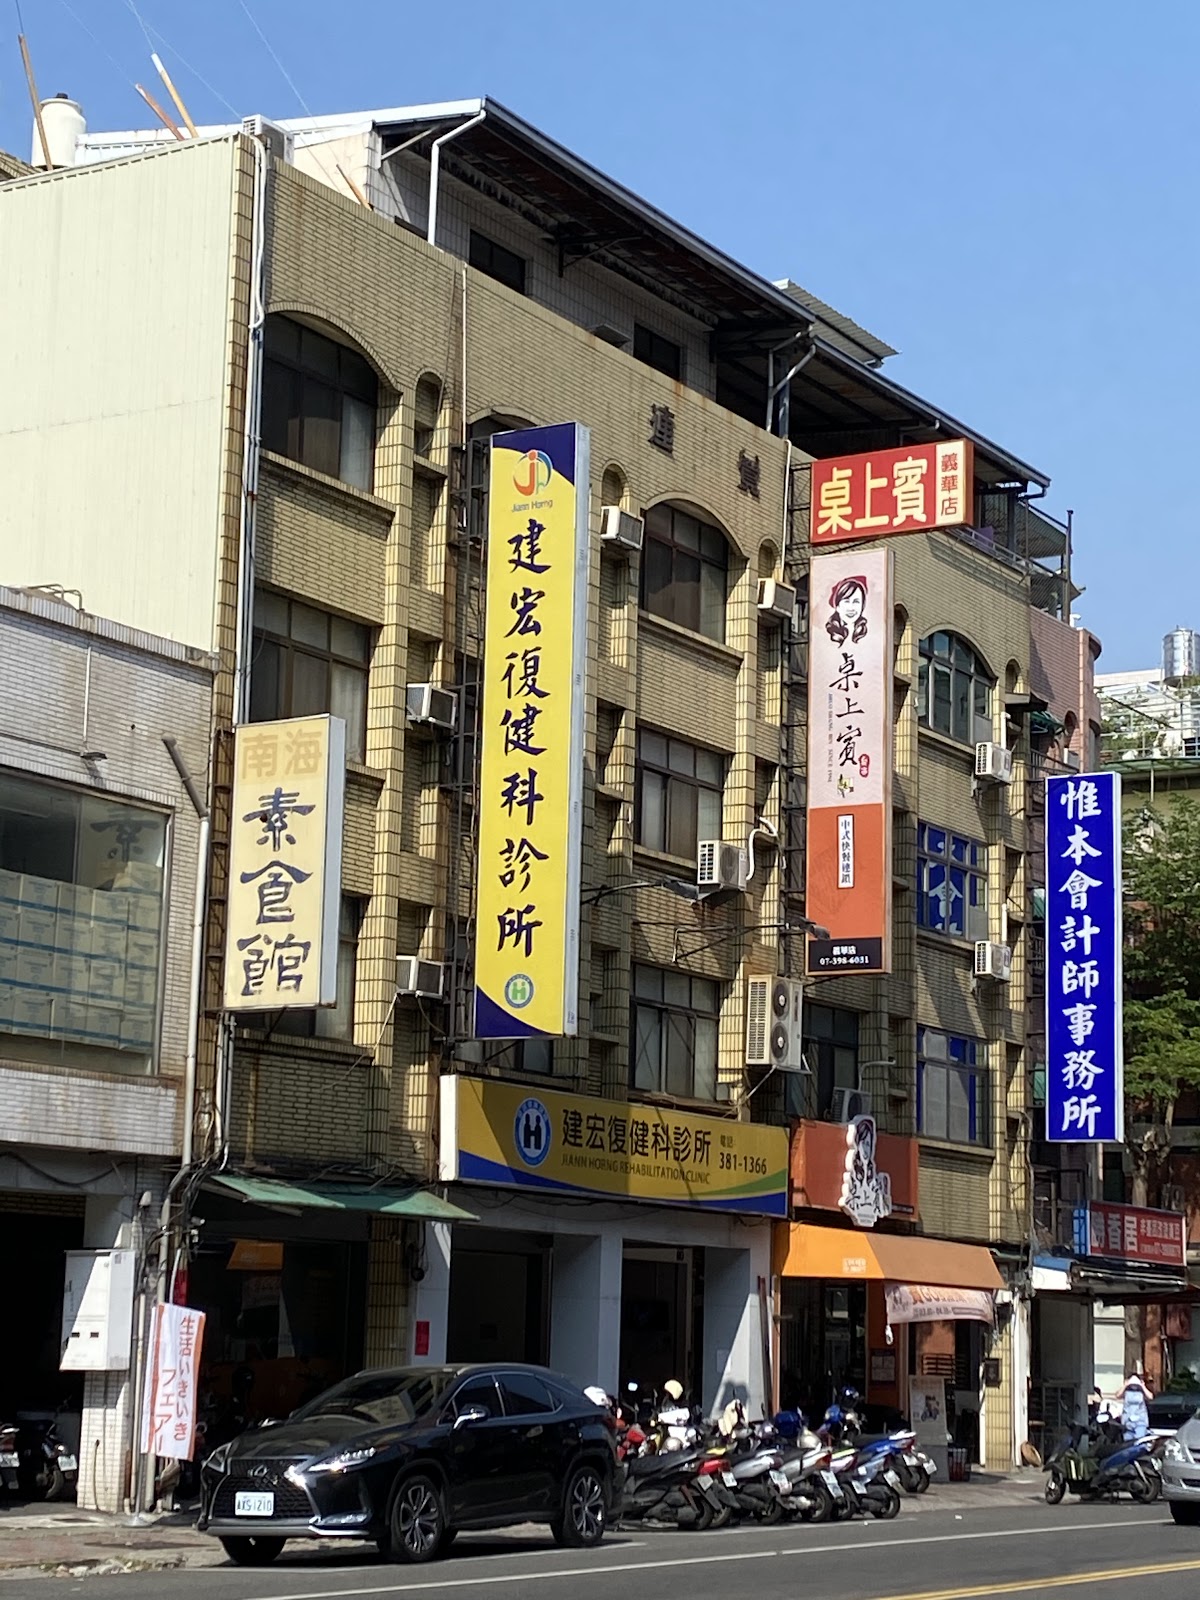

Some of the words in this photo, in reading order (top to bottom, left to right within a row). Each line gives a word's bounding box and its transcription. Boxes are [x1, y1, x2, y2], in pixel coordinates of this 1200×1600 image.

[817, 456, 928, 535] 桌上賓
[941, 452, 958, 517] 義華店
[497, 518, 552, 958] 建宏復健科診所
[829, 652, 865, 767] 桌上賓
[237, 787, 316, 997] 素食館
[1059, 780, 1104, 1138] 惟本會計師事務所
[561, 1154, 588, 1168] JIANN
[589, 1158, 619, 1173] HORNG
[619, 1161, 685, 1181] REHABILITATION
[686, 1169, 711, 1185] CLINIC
[562, 1109, 712, 1167] 建宏復健科診所
[719, 1152, 767, 1175] 381-1366
[173, 1315, 196, 1442] 生活いきいき
